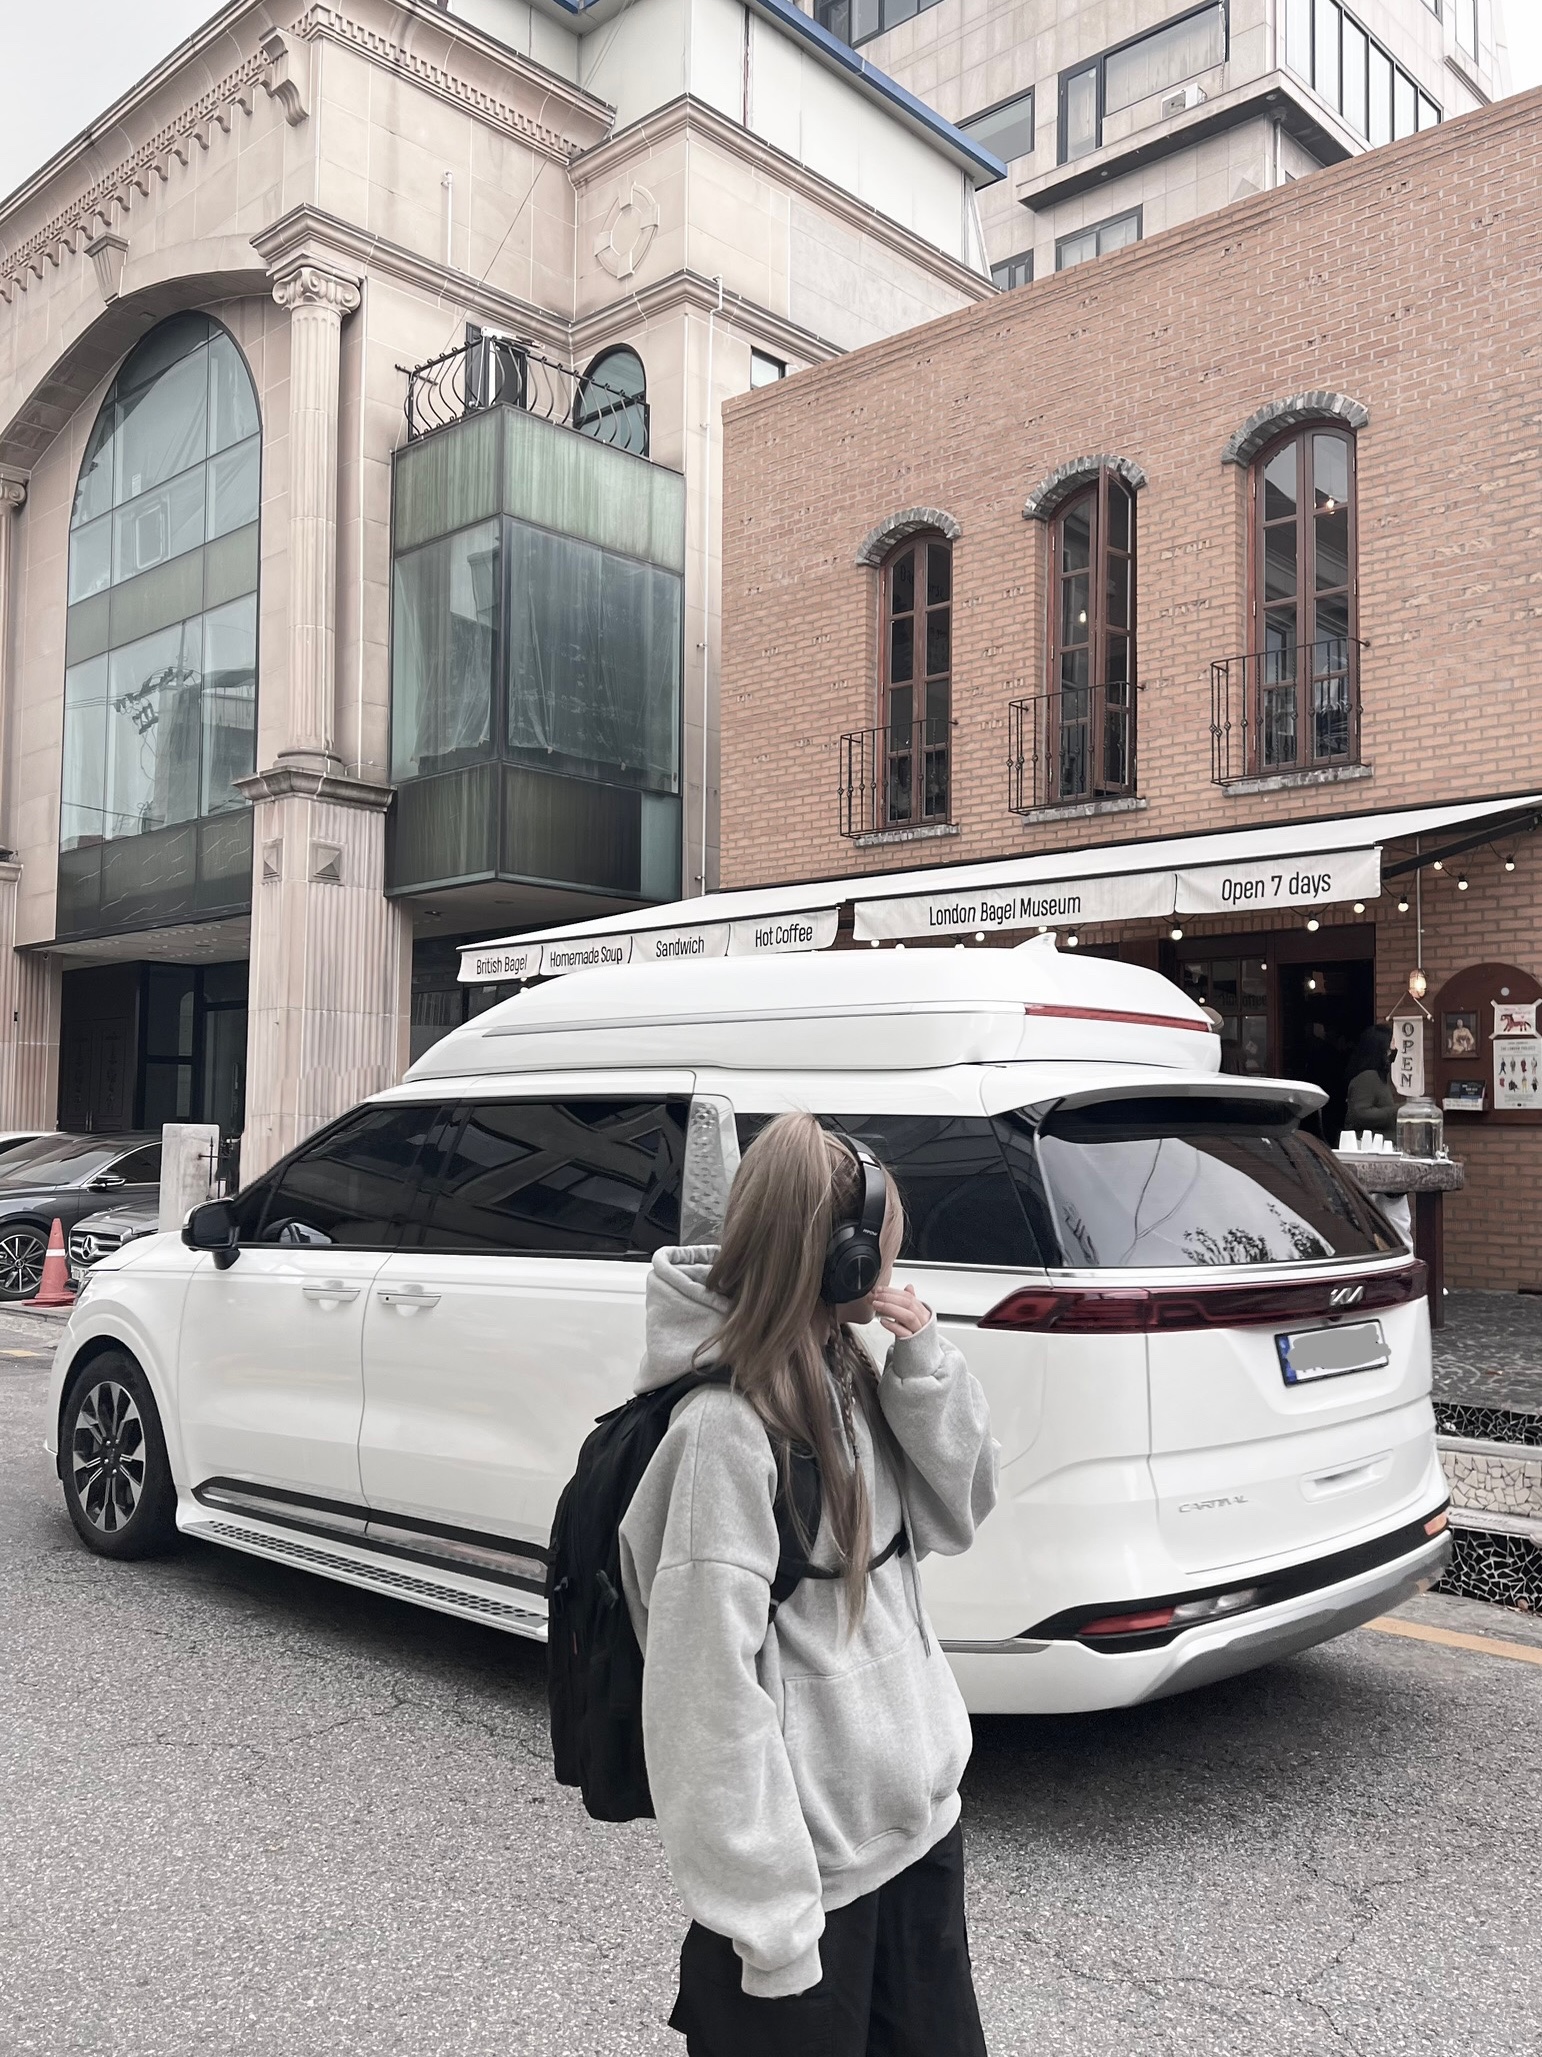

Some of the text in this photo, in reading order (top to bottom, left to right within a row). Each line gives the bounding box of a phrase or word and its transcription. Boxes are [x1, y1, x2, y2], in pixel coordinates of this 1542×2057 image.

[1221, 871, 1332, 905] Open 7 days
[929, 896, 1081, 926] London Bagel Museum
[655, 935, 705, 958] Sandwich
[755, 923, 813, 948] Hot Coffee
[476, 953, 528, 975] British Bagel
[550, 946, 623, 968] Homemade Soup
[1400, 1022, 1415, 1088] OPEN
